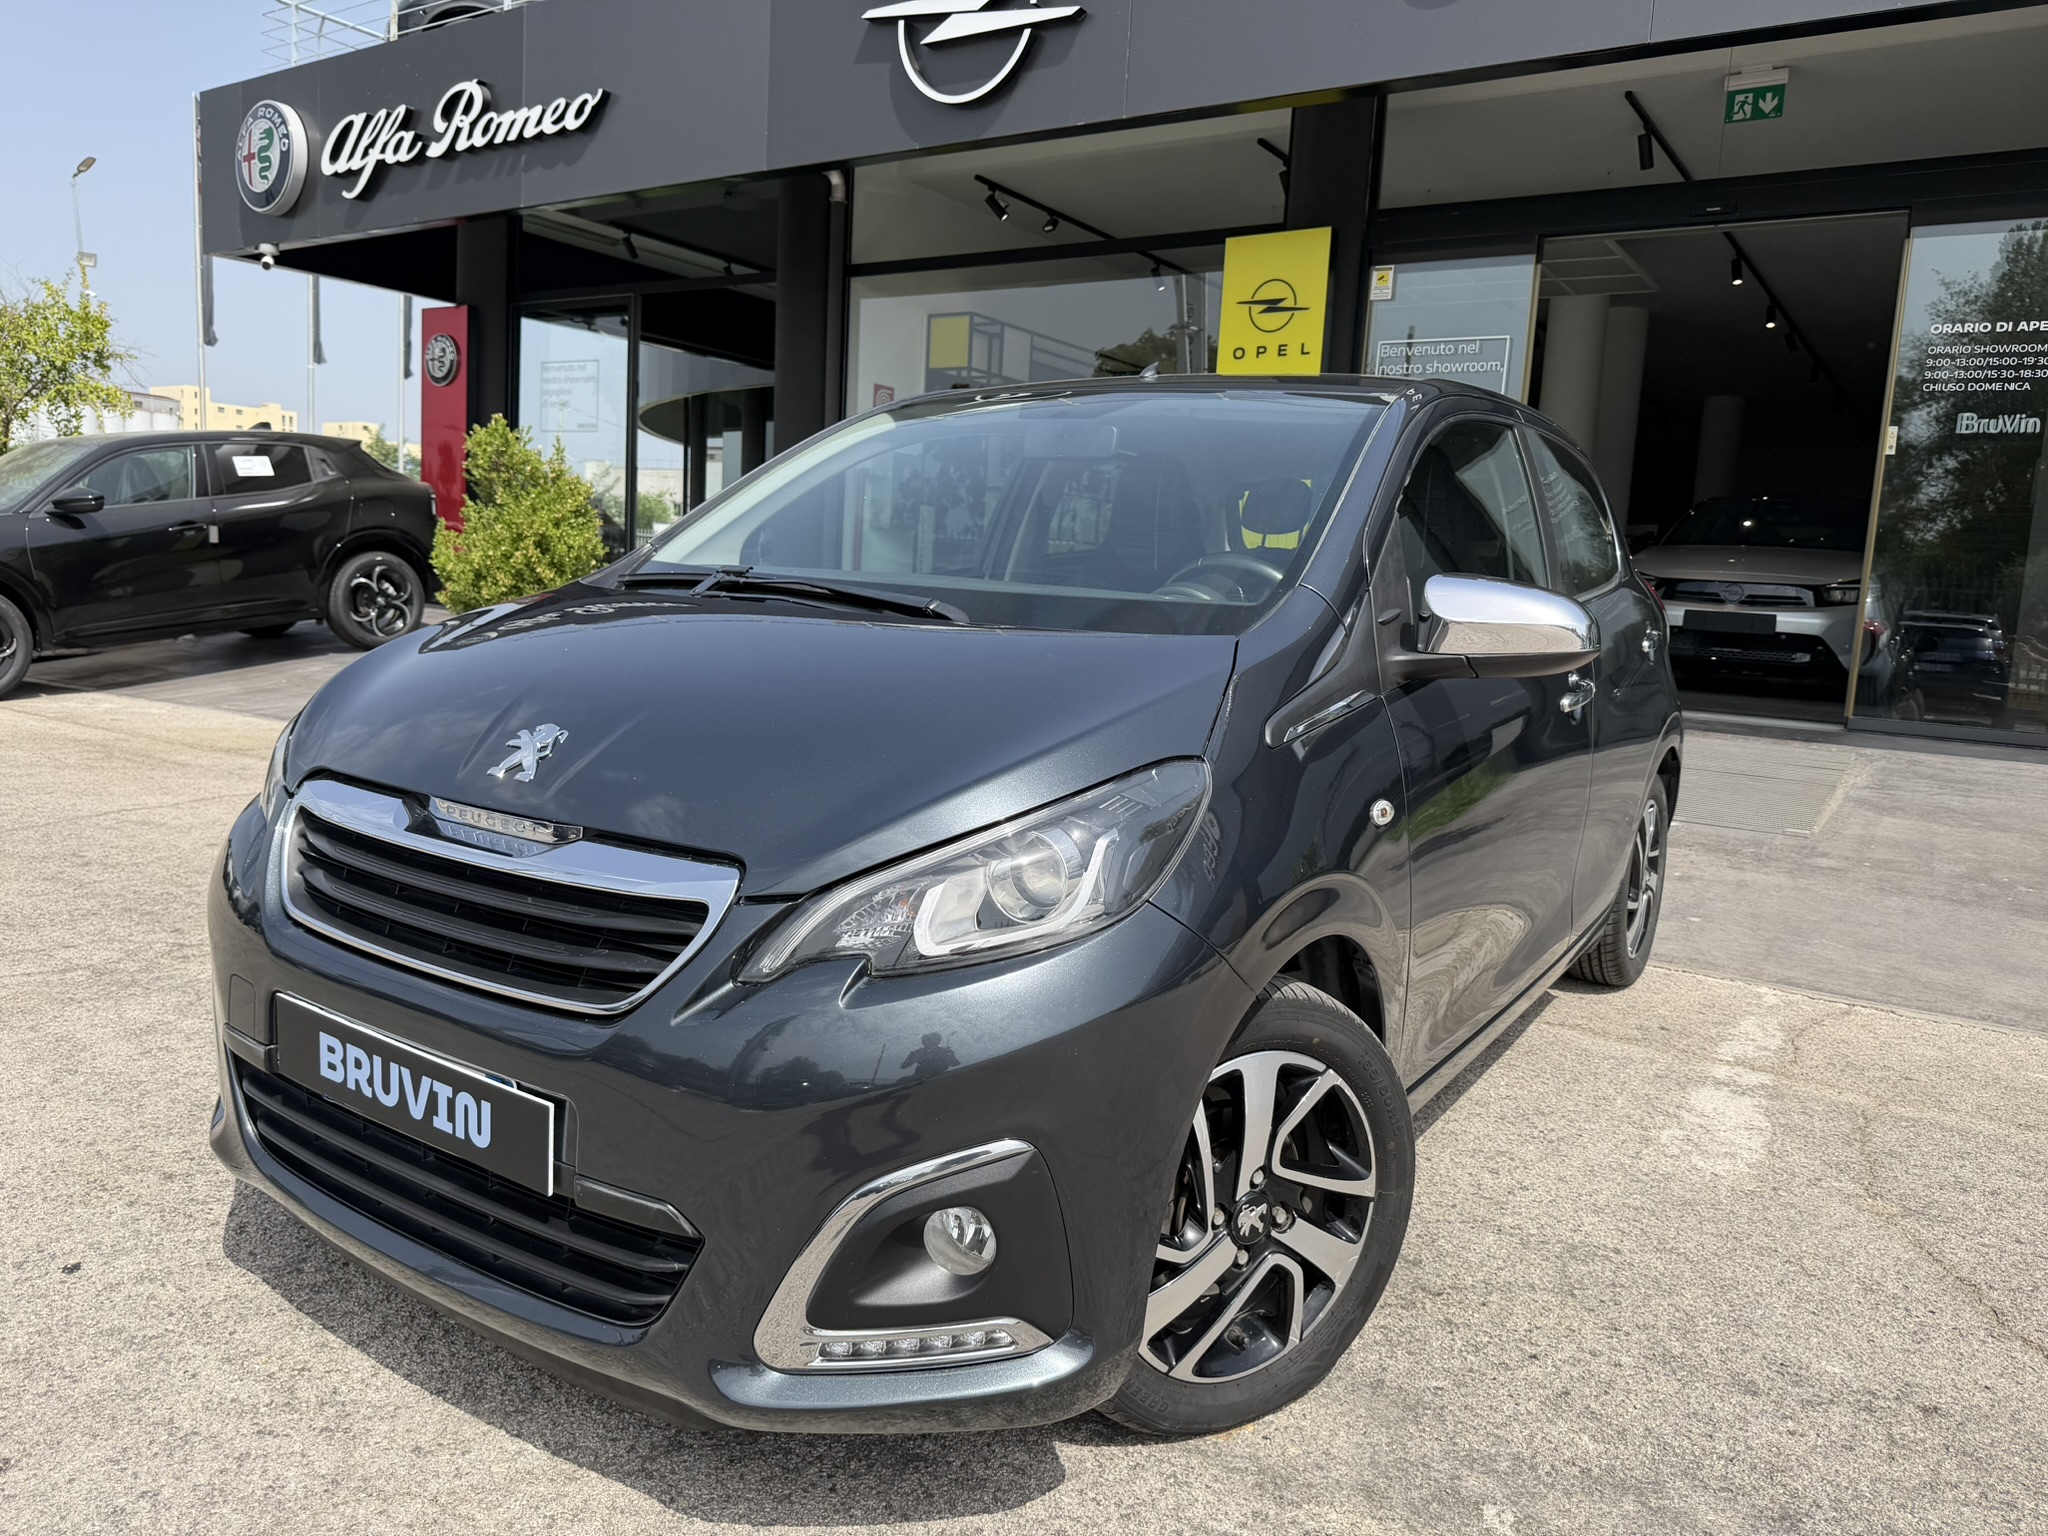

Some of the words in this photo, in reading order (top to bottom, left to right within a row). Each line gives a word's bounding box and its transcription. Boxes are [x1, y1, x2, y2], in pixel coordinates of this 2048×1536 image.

[257, 107, 289, 152] ROMEO
[320, 104, 423, 200] Alfa
[425, 78, 604, 159] Romeo
[1930, 322, 1992, 334] ORARIO
[1996, 321, 2013, 332] DI
[2016, 320, 2048, 332] APE
[1232, 343, 1311, 360] OPEL
[1380, 342, 1454, 358] Benvenuto
[1457, 340, 1480, 354] nel
[1927, 345, 1971, 355] ORARIO
[1974, 344, 2048, 354] SHOWROOM
[1378, 362, 1423, 376] nostro
[1425, 359, 1504, 374] showroom,
[1922, 383, 1965, 392] CHIUSO
[1967, 382, 2031, 391] DOMENICA
[319, 1031, 492, 1149] BRUVIN
